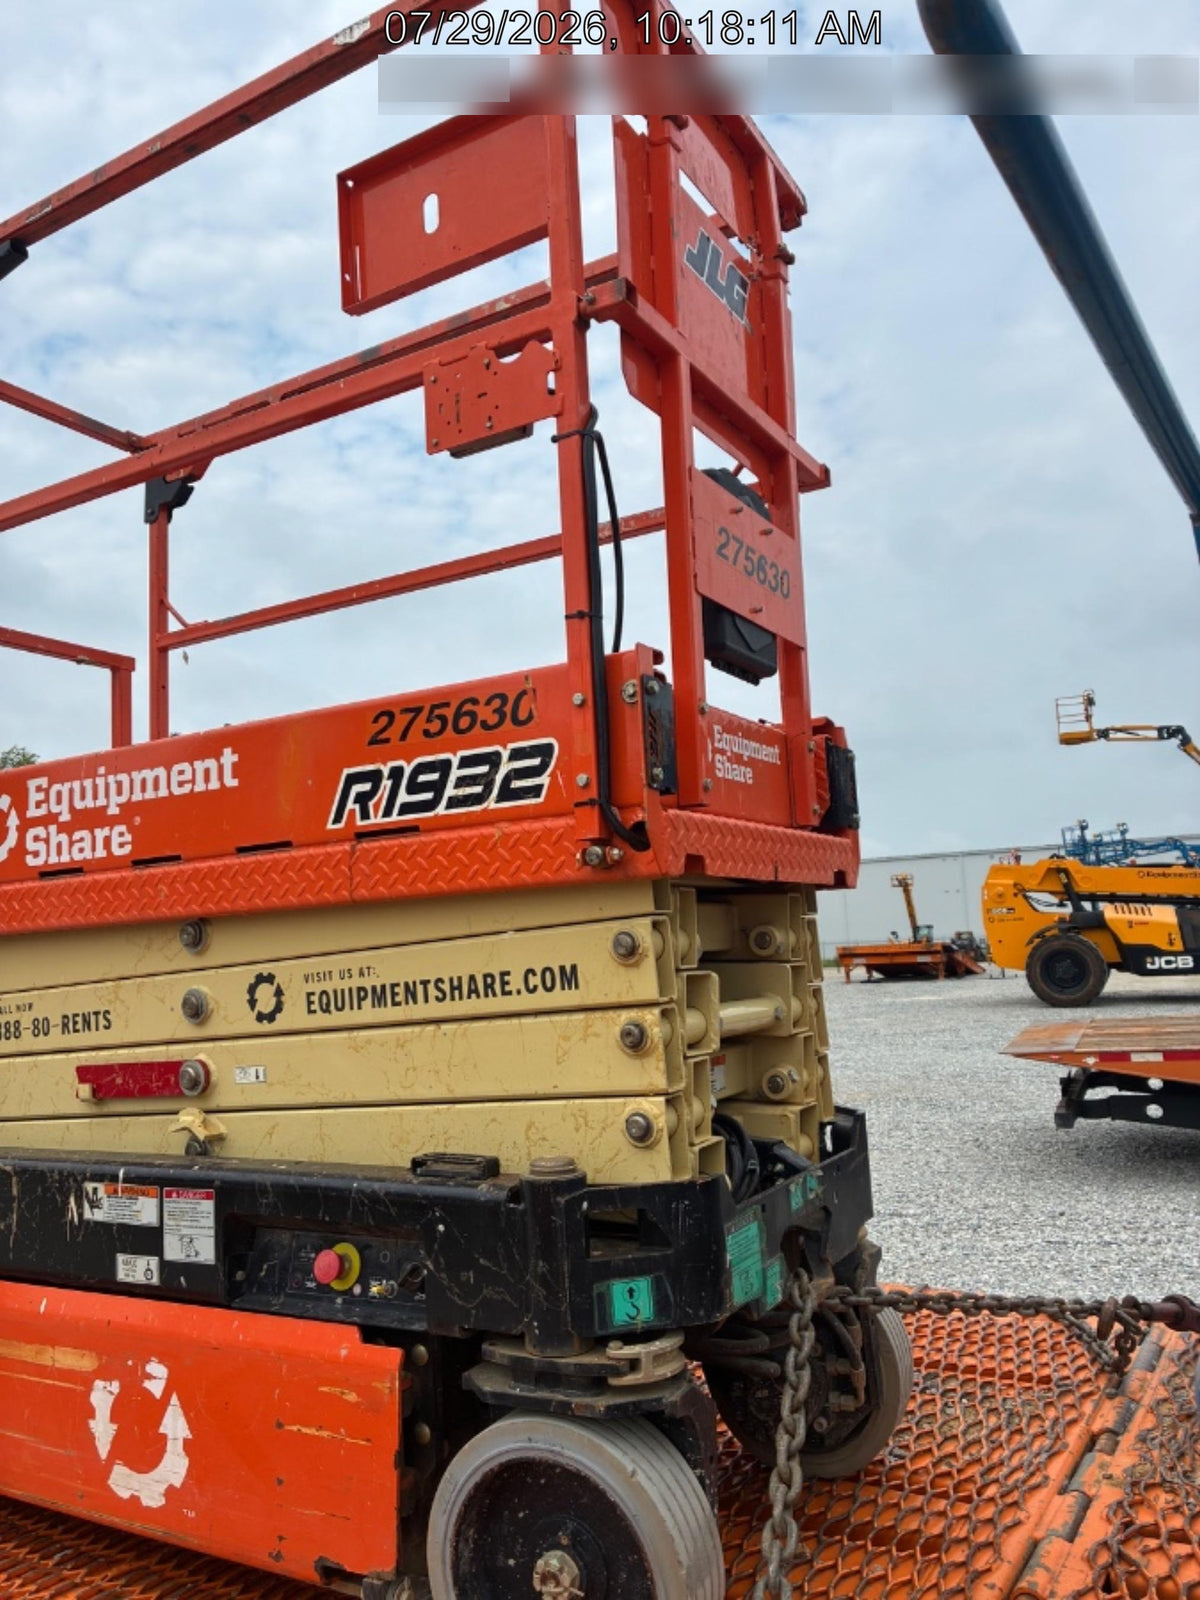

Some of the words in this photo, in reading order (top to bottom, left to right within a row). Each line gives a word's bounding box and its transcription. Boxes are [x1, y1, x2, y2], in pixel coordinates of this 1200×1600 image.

[684, 227, 750, 324] JLG
[716, 526, 790, 599] 275630
[366, 688, 537, 747] 275630
[713, 725, 781, 765] Equipment
[26, 747, 239, 822] Equipment
[326, 737, 559, 830] R1932
[715, 754, 753, 784] Share
[25, 824, 132, 867] Share
[303, 970, 334, 984] VISIT
[339, 968, 353, 980] US
[1146, 956, 1194, 969] JCB
[306, 964, 580, 1015] EQUIPMENTSHARE.COM
[0, 1009, 112, 1041] 88-80-RENTS
